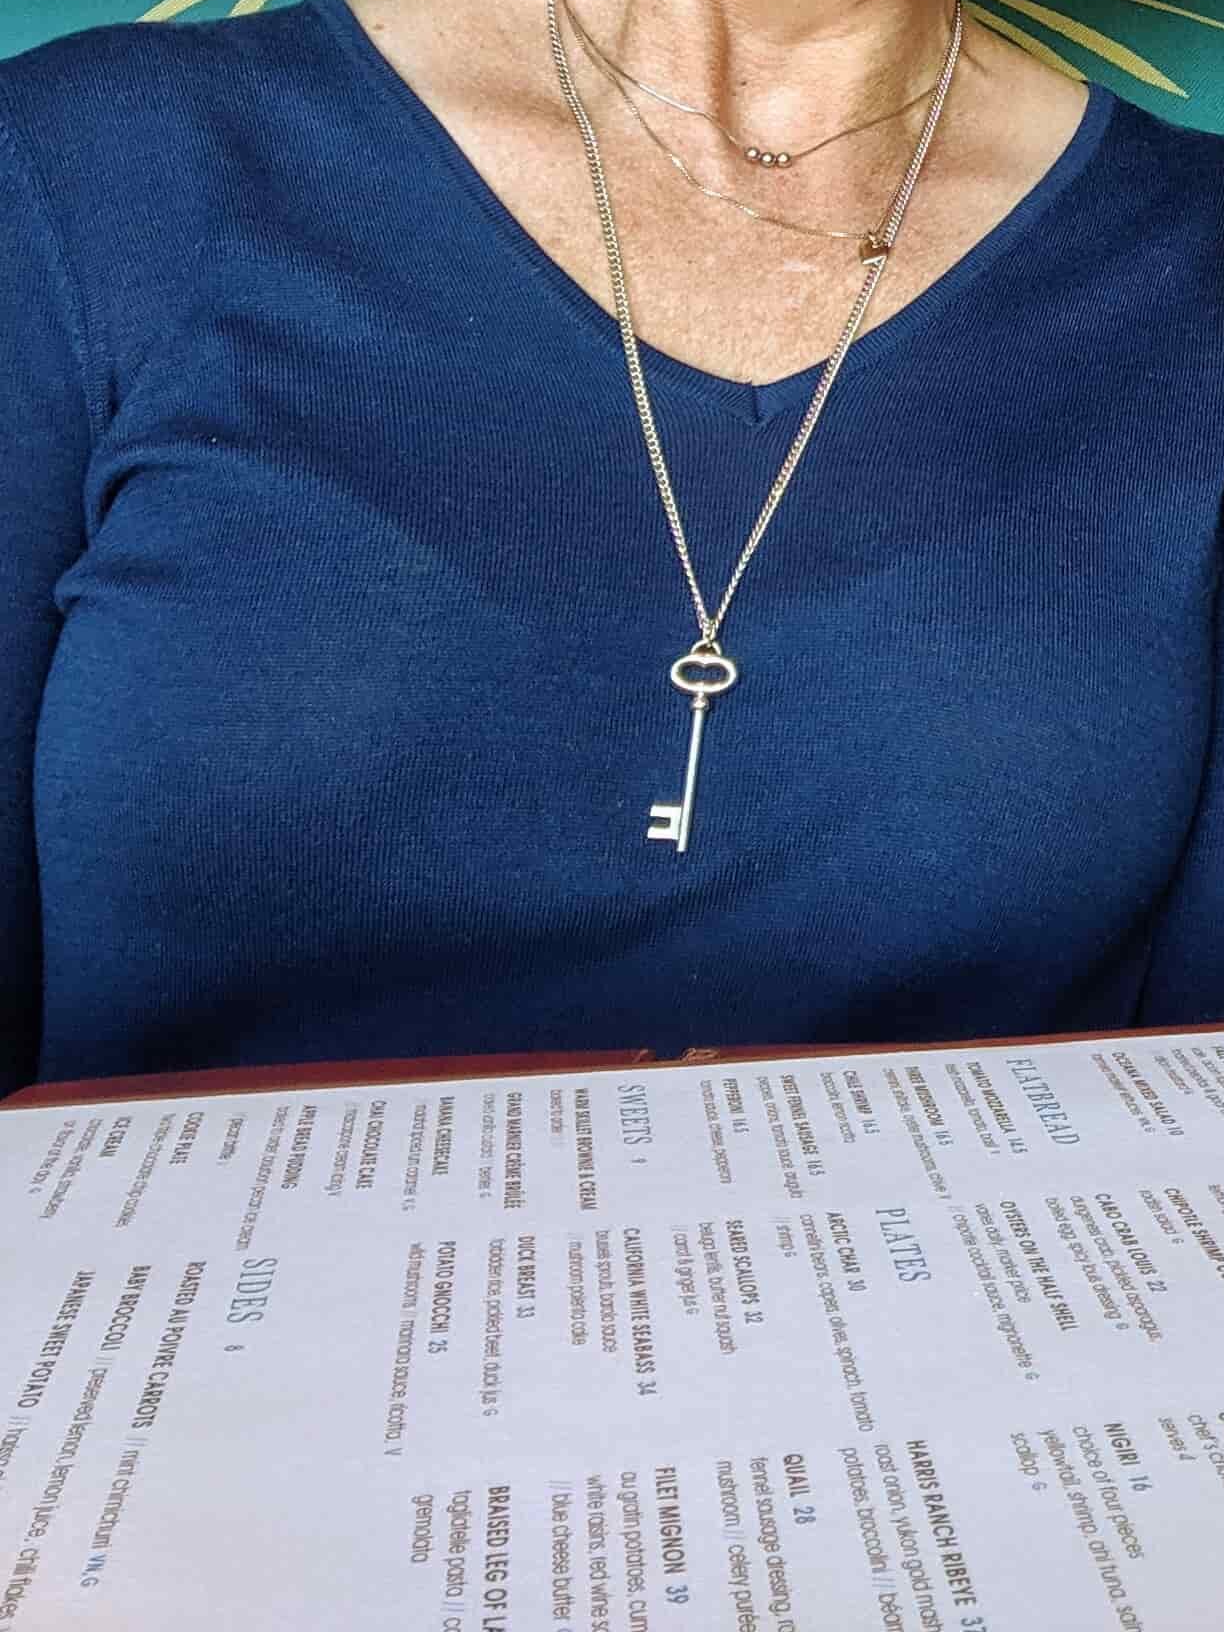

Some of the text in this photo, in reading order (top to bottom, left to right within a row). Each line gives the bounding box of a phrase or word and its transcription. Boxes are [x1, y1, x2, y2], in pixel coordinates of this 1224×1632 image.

[617, 1084, 652, 1144] SWEETS
[1006, 1059, 1081, 1144] FLATBREAD
[124, 1265, 151, 1290] BABY
[516, 1236, 535, 1318] DUCK BREAST 33
[725, 1220, 763, 1323] SEARED SCALLOPS 32
[874, 1208, 932, 1281] PLATES
[998, 1201, 1078, 1330] OYSTERS ON THE HALF SHELL
[100, 1293, 140, 1350] BROCCOLI
[225, 1257, 277, 1323] SIDES
[427, 1241, 455, 1353] POTATO GNOCCHI 25
[623, 1227, 656, 1395] CALIFORNIA WHITE SEABASS 34
[16, 1270, 95, 1408] JAPANESE SWEET POTATO
[130, 1261, 206, 1428] ROASTED AU POIVRE CARROTS
[782, 1453, 816, 1524] QUAIL 28
[906, 1440, 939, 1489] HARRIS
[1102, 1423, 1153, 1491] NIGIRI 16
[409, 1494, 433, 1563] gremolata
[445, 1489, 471, 1597] tagliatelle pasta
[486, 1485, 509, 1547] BRAISED
[654, 1467, 689, 1604] FILET MIGNON 39
[922, 1493, 958, 1547] RANCH
[484, 1552, 508, 1582] LEG
[551, 1493, 574, 1620] blue cheese butter
[940, 1552, 977, 1605] RIBEYE
[483, 1588, 507, 1610] OF
